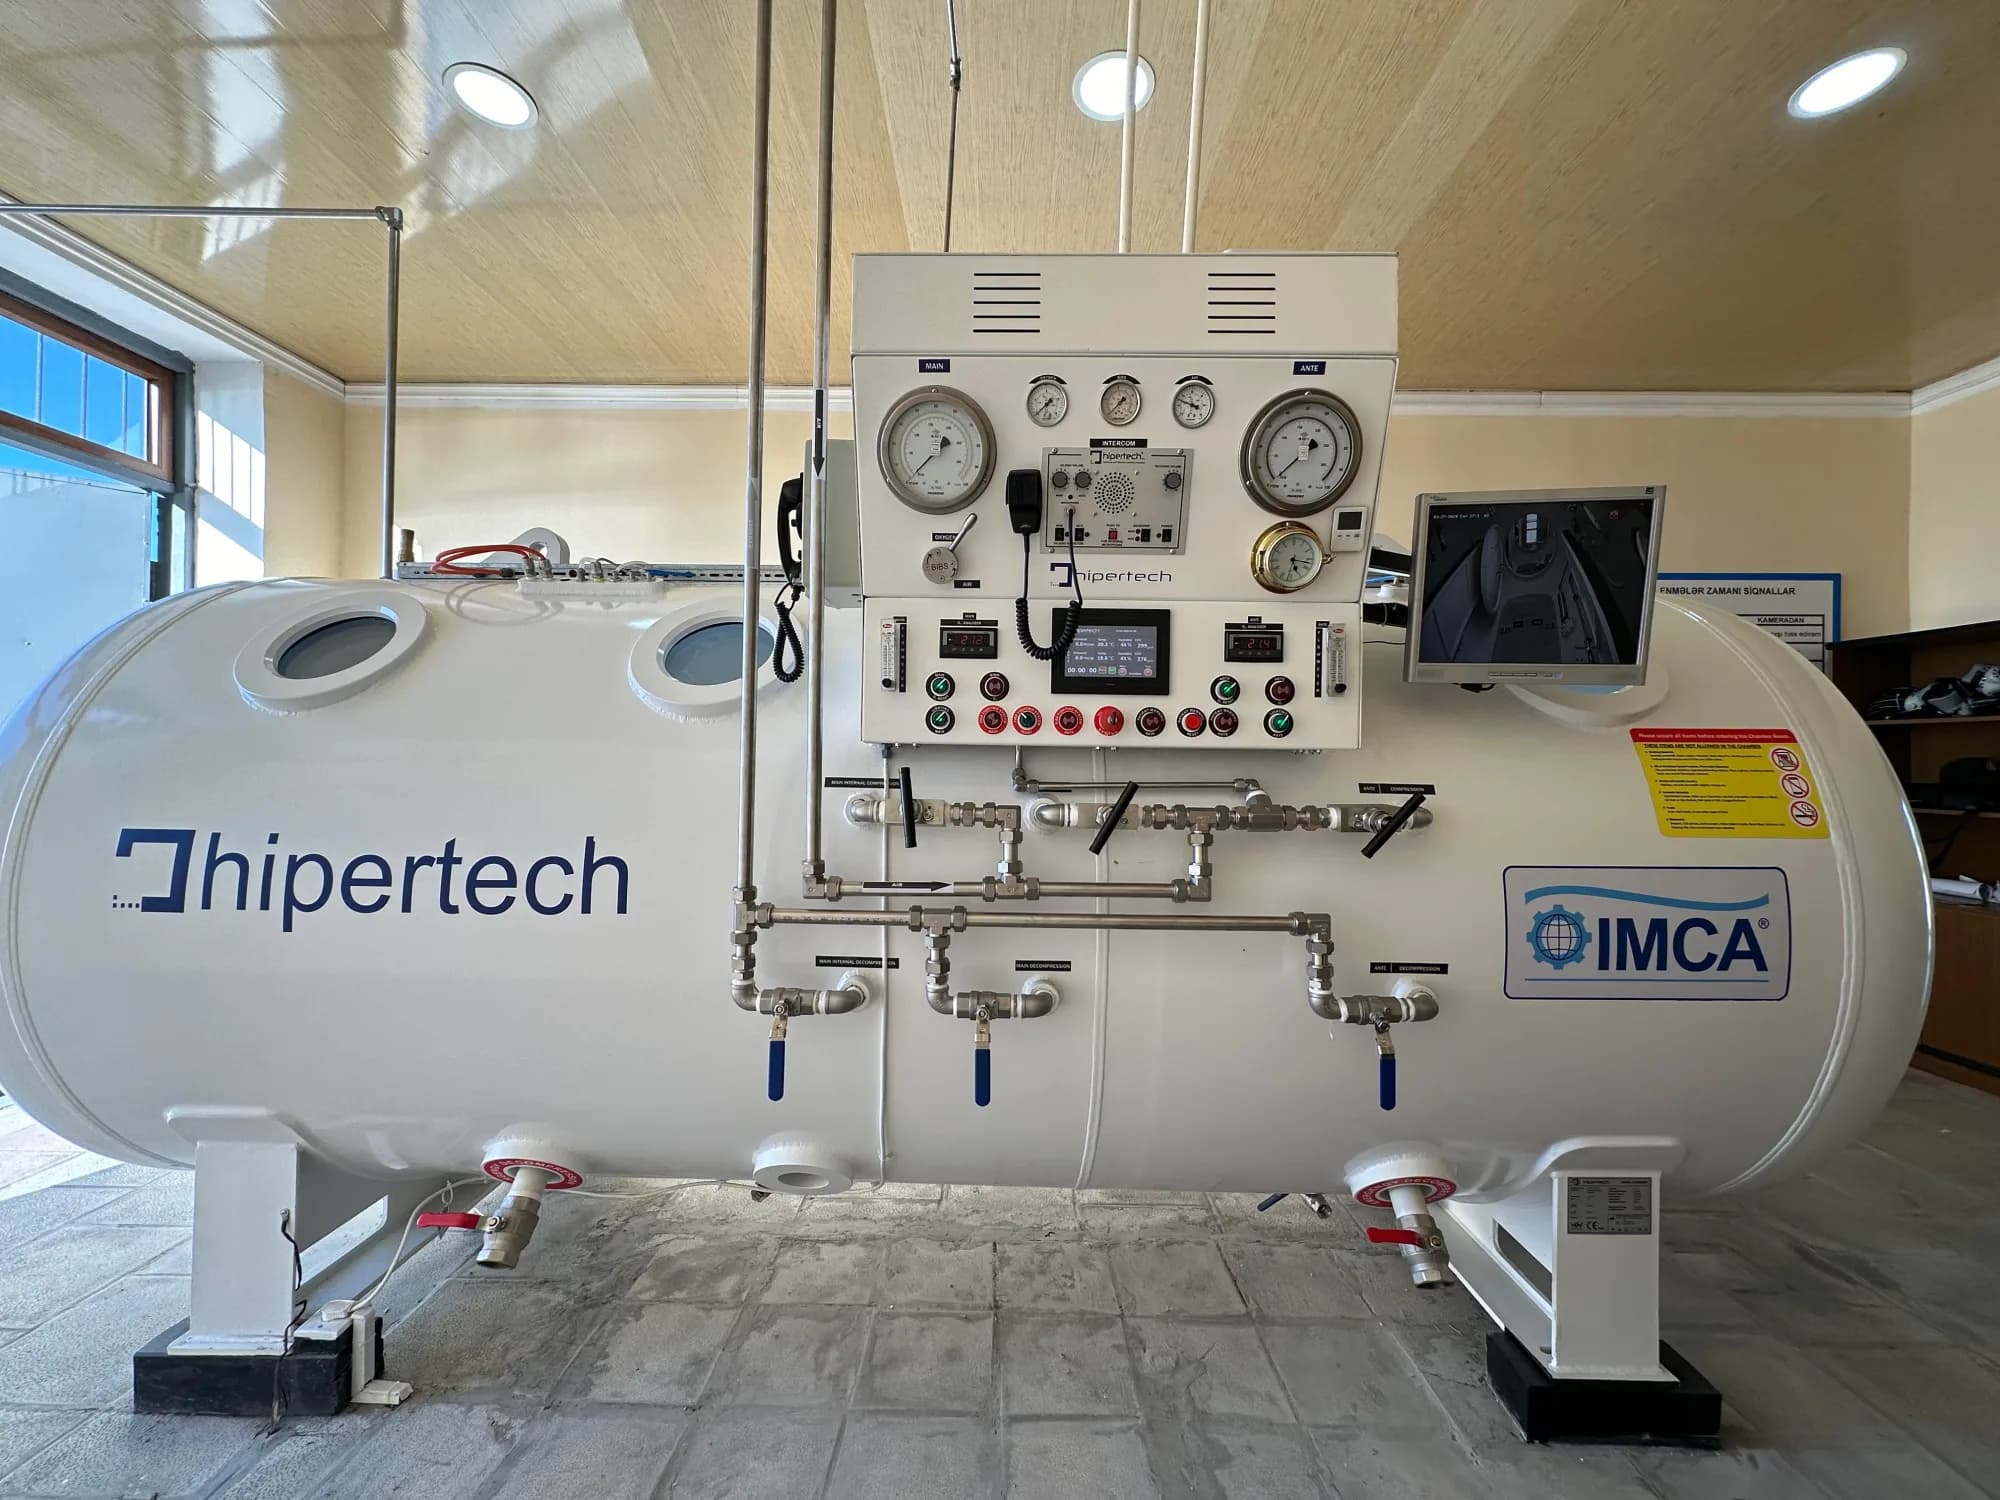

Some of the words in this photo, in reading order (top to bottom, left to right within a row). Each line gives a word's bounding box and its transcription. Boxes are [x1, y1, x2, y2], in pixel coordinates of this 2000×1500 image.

[925, 362, 944, 370] MAIN
[1300, 364, 1319, 372] ANTE
[1102, 451, 1142, 460] hipertech
[931, 562, 949, 571] BIBS
[1706, 587, 1741, 595] ZAMANI
[1743, 585, 1796, 596] SİQNALLAR
[200, 832, 629, 933] hipertech
